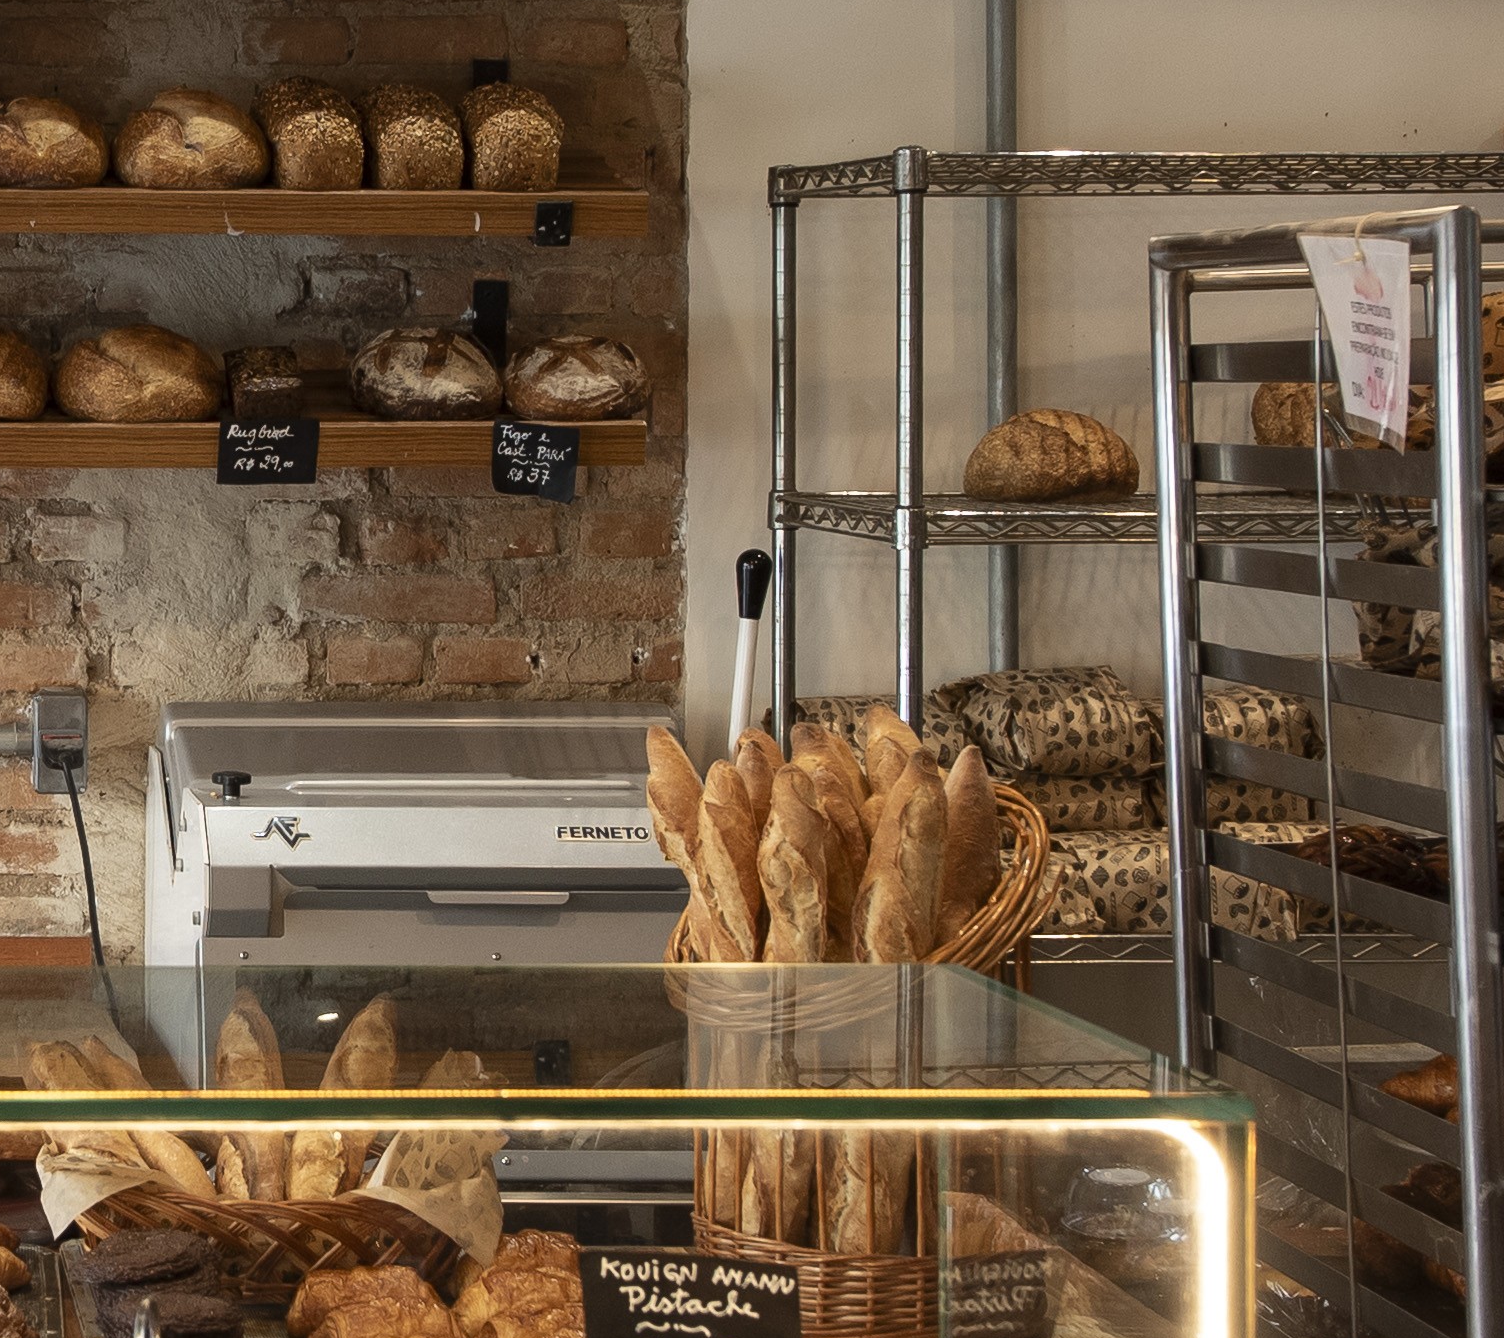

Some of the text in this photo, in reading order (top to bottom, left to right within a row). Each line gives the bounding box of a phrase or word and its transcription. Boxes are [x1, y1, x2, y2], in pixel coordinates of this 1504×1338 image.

[500, 424, 550, 445] Figo e
[536, 447, 572, 461] PARÁ
[233, 458, 254, 471] R$
[507, 467, 550, 485] R$ 37
[557, 825, 650, 841] FERNETO
[619, 1286, 760, 1319] Pistache
